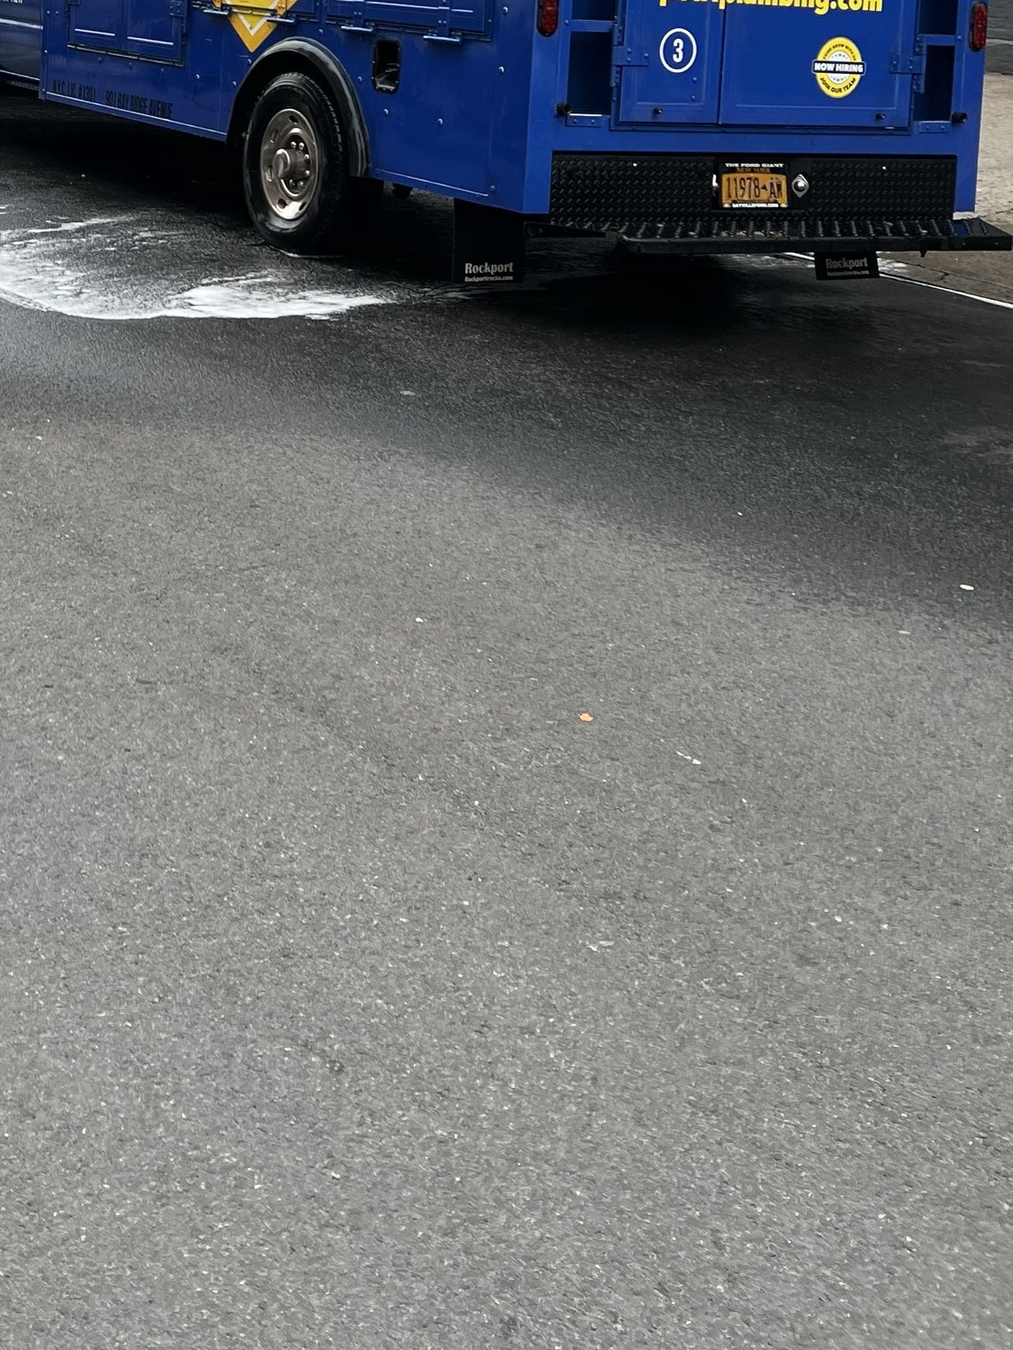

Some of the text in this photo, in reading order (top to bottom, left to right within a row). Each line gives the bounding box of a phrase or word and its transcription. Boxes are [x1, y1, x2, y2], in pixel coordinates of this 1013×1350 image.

[672, 38, 684, 63] 3
[814, 62, 864, 73] NOW HIRING
[464, 262, 514, 275] Rockport
[825, 257, 868, 269] Rockport
